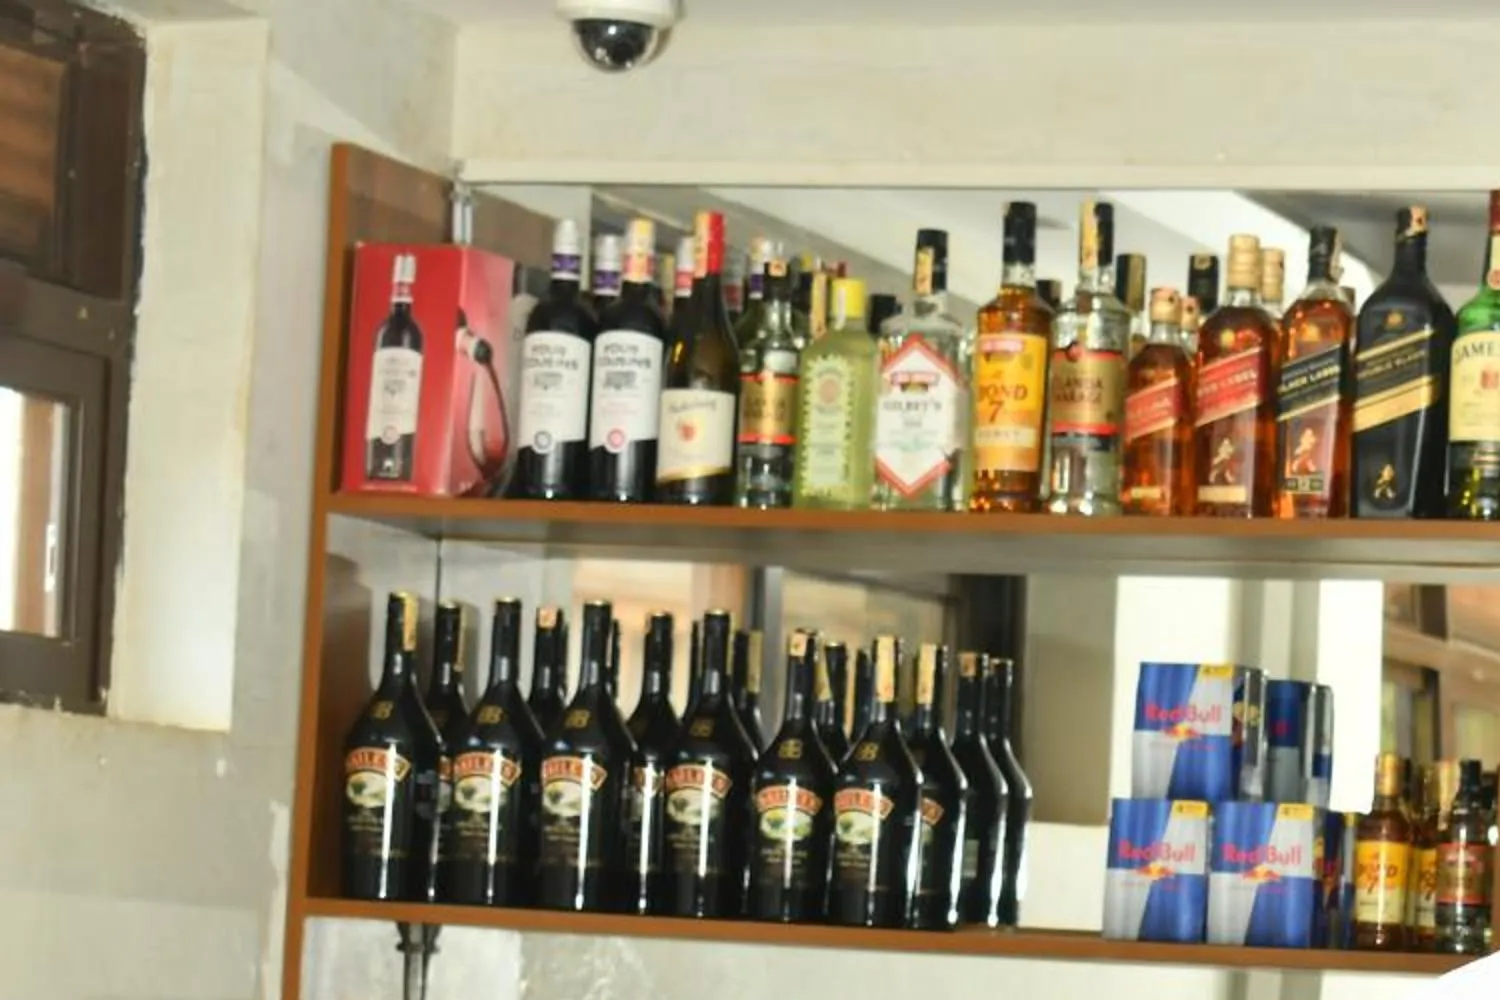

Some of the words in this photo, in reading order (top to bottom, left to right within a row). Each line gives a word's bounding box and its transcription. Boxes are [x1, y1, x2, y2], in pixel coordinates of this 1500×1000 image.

[989, 401, 1004, 424] 7
[1144, 703, 1183, 723] Red
[1186, 704, 1222, 724] Bull
[1118, 839, 1155, 861] Red
[1160, 842, 1196, 863] Bull
[1222, 842, 1261, 863] Red
[1266, 844, 1302, 865] Bull
